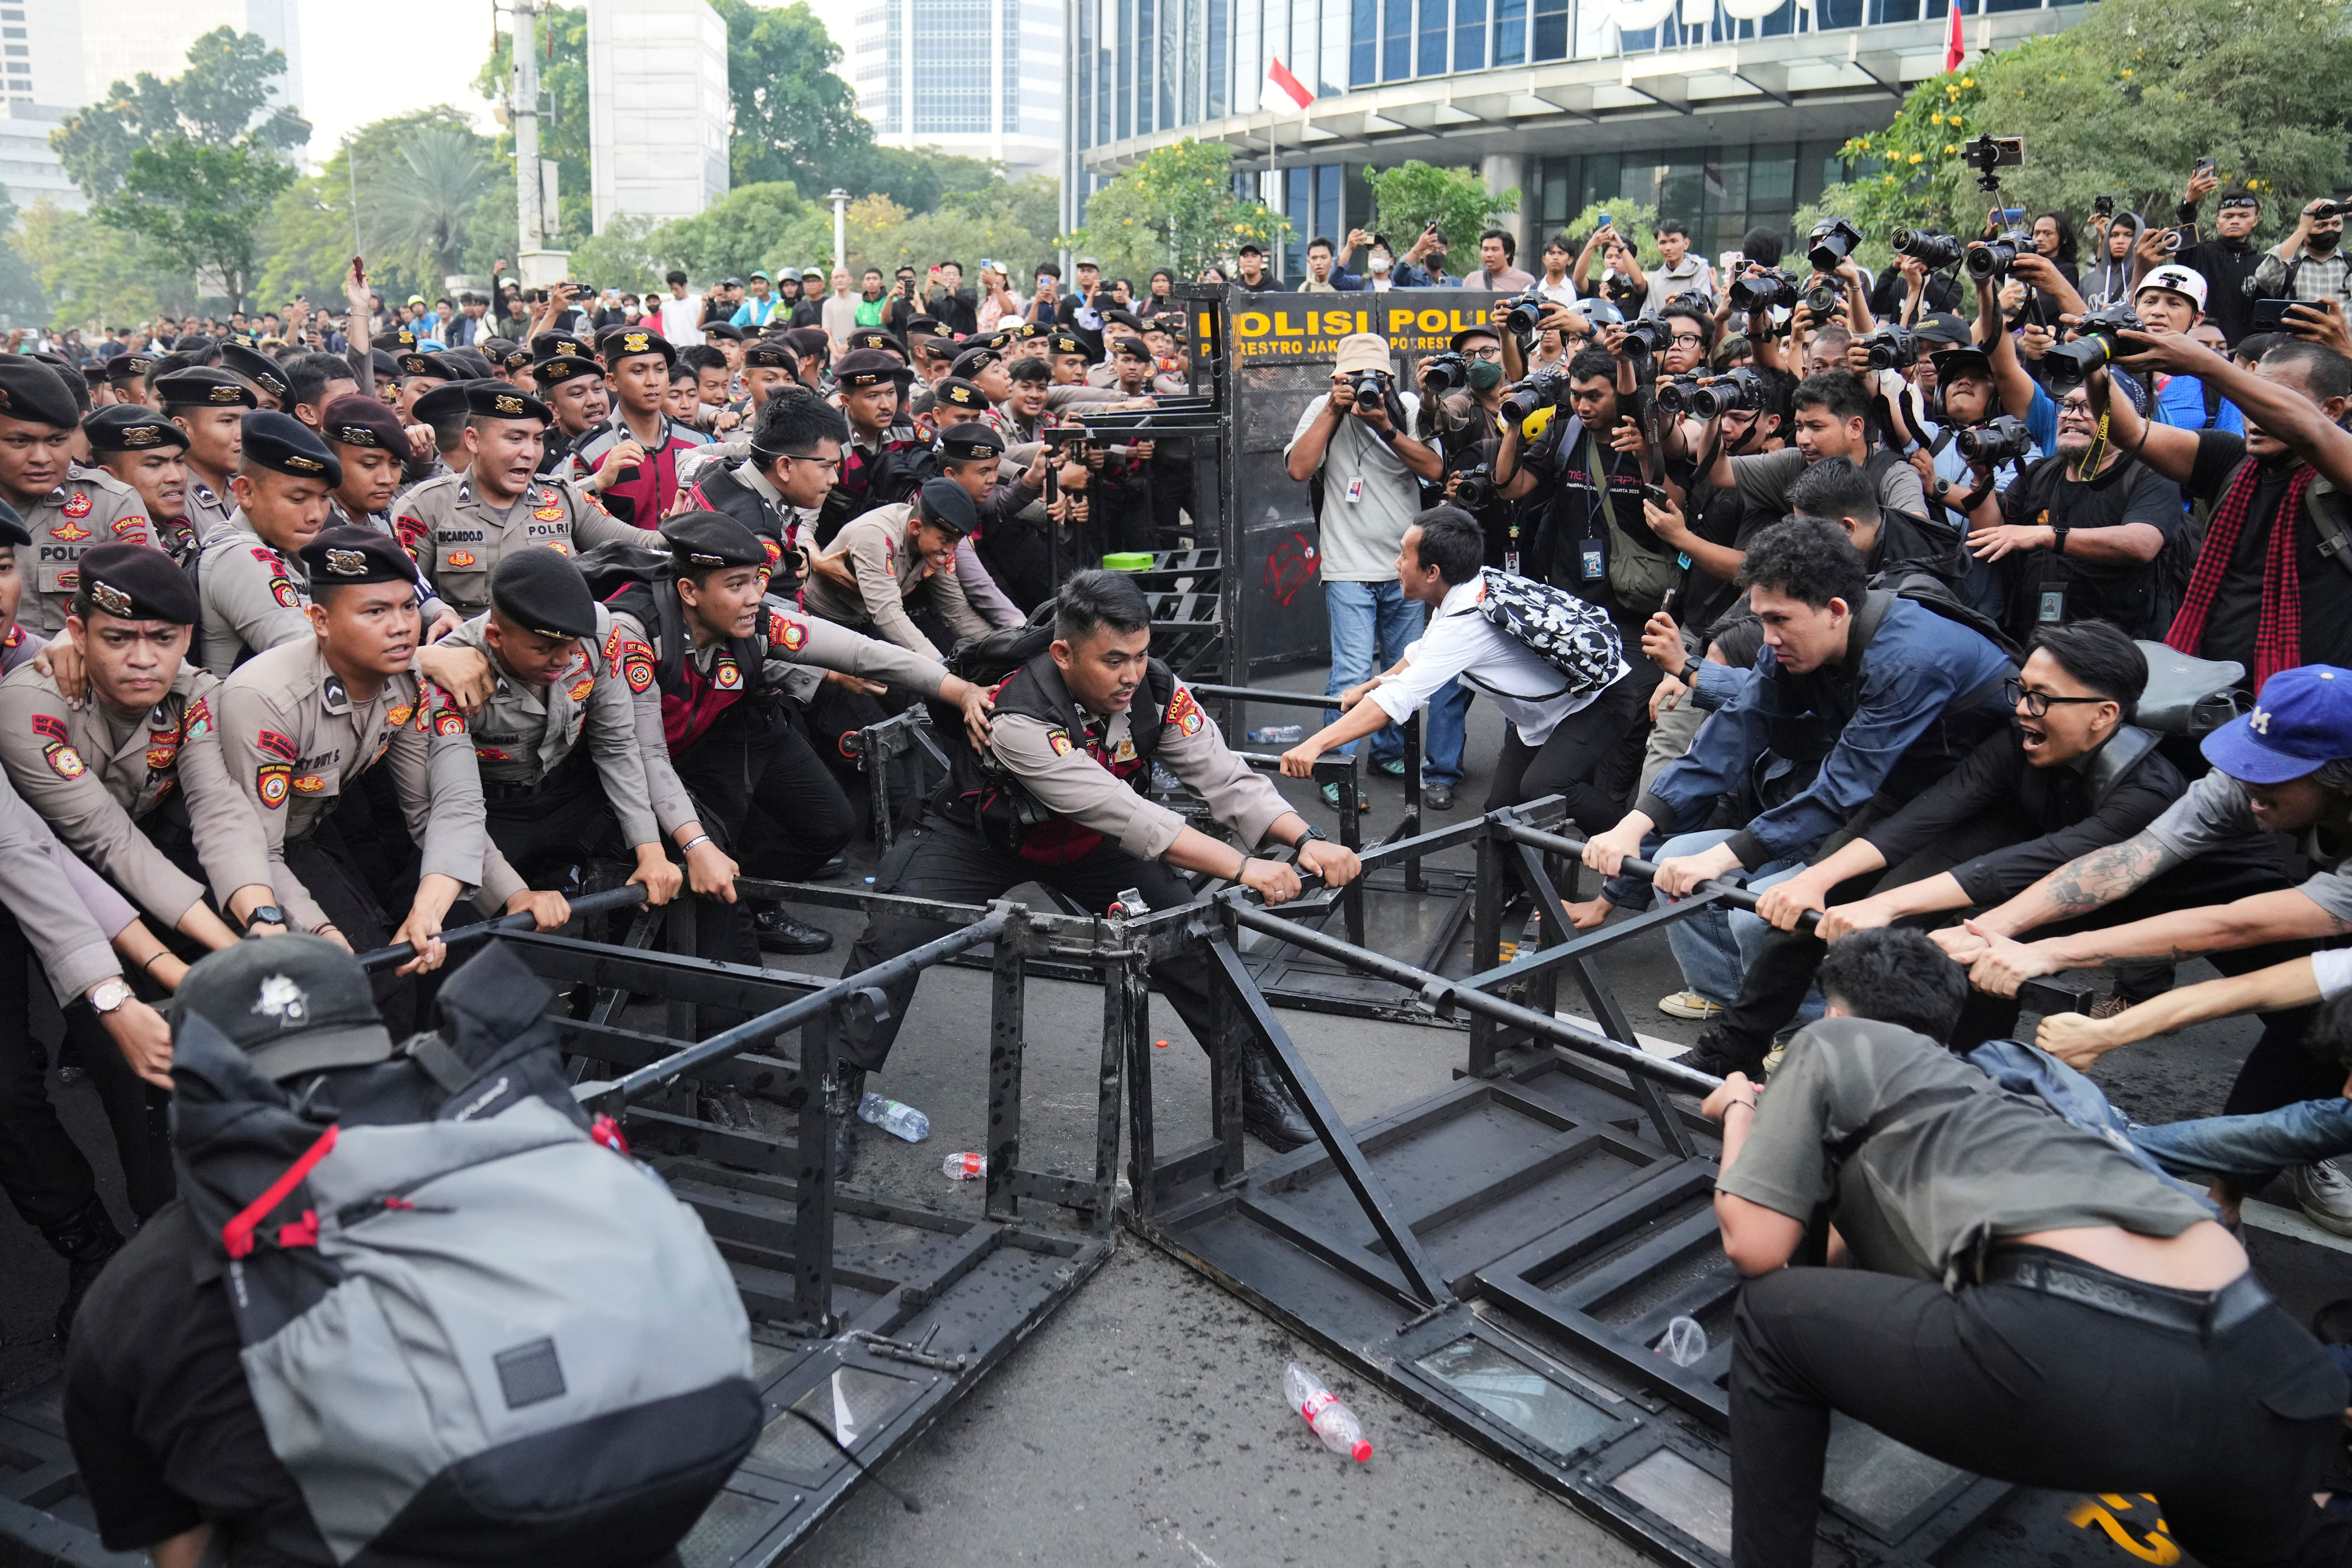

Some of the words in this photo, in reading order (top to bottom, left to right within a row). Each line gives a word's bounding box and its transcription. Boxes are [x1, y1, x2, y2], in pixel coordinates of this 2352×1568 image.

[1390, 309, 1495, 333] POLI
[115, 517, 144, 531] POLDA
[528, 523, 569, 536] POLRI
[404, 533, 412, 542] 9
[438, 531, 483, 542] RICARDO.D
[1169, 691, 1187, 720] POLDA
[2249, 706, 2271, 735] M
